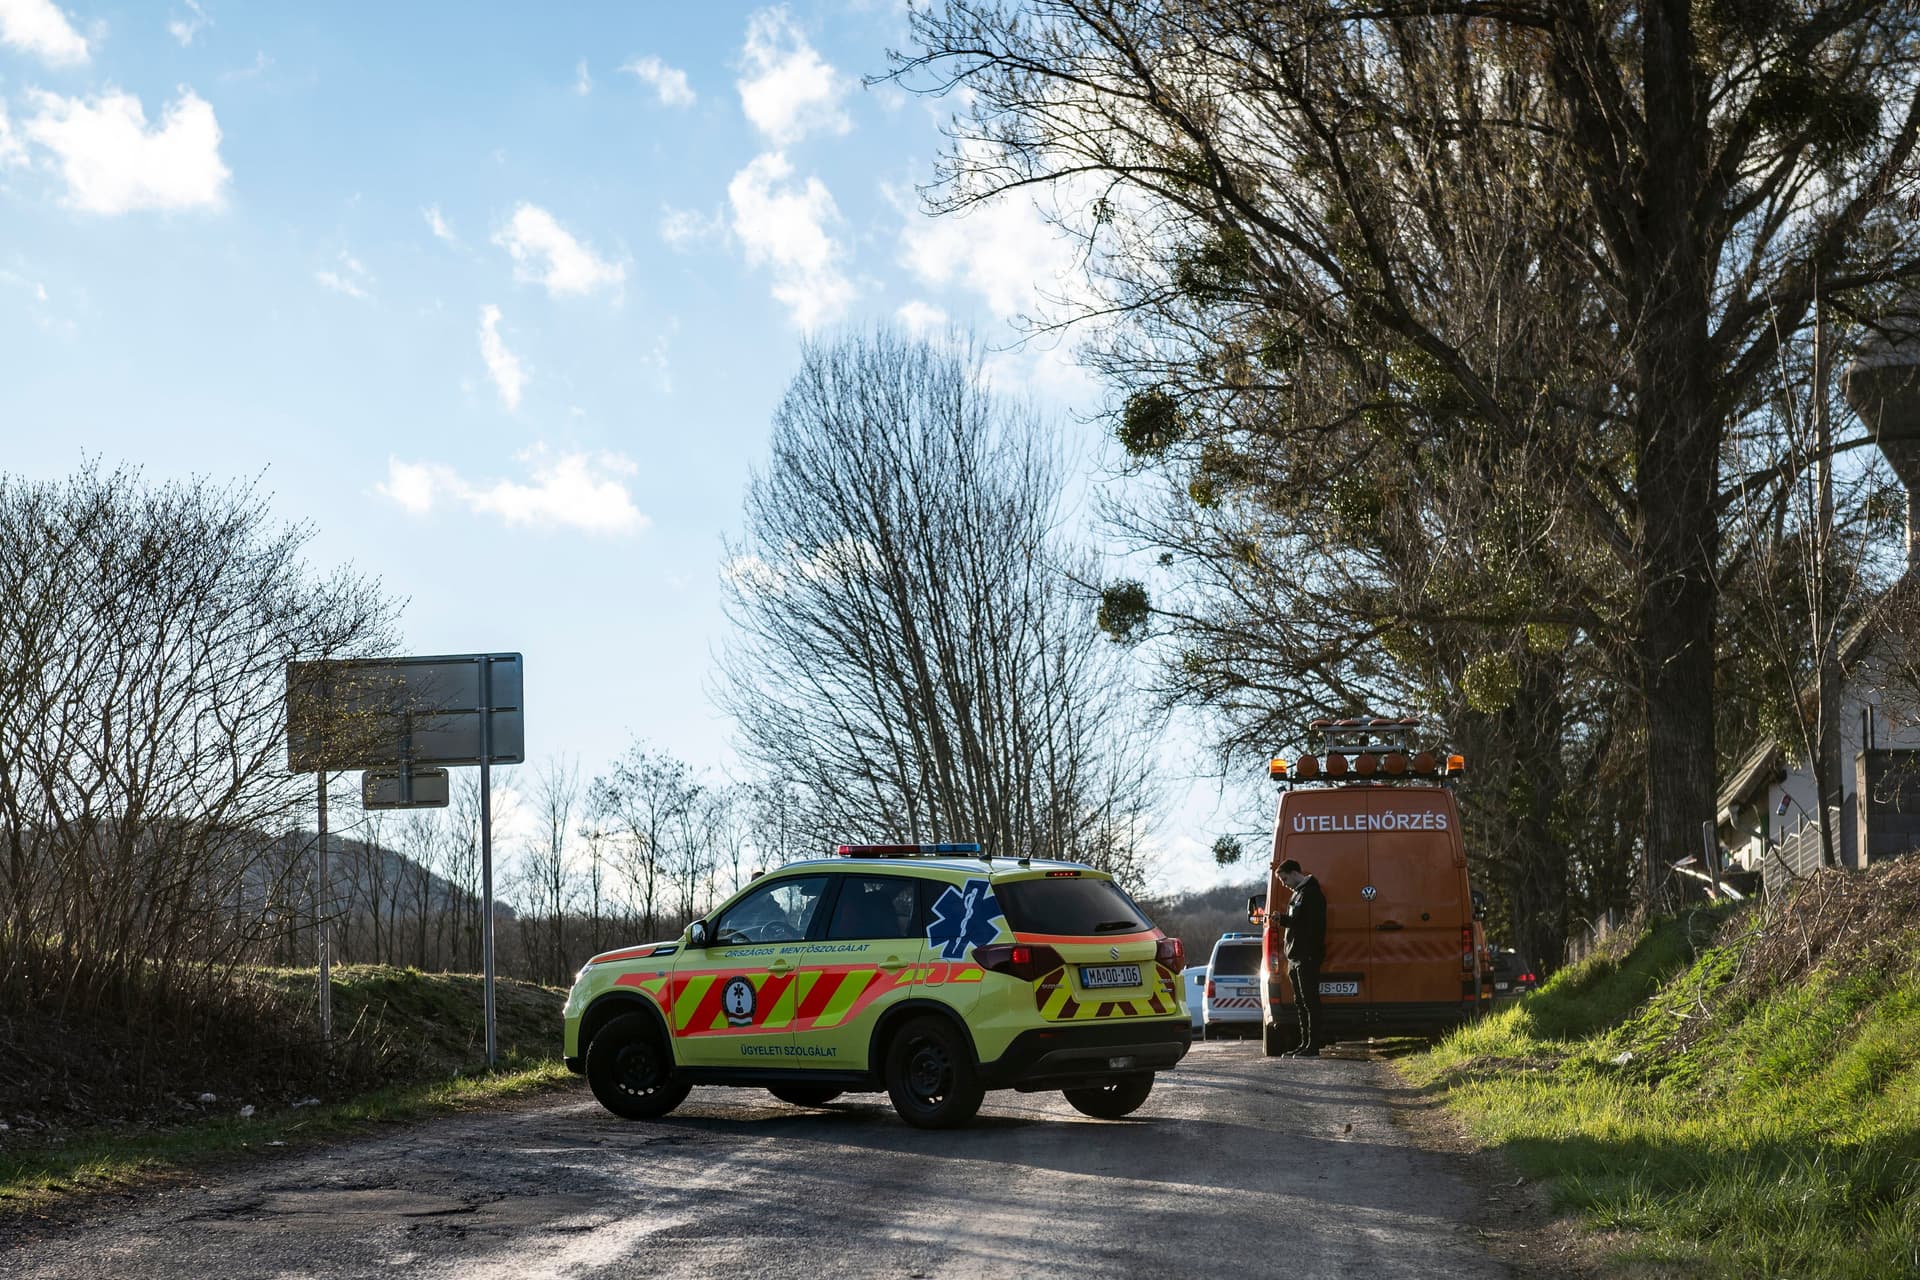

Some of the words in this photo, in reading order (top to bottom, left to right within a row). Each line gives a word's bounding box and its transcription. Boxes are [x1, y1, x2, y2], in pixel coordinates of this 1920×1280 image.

[1293, 810, 1448, 832] ÚTELLENŐRZÉS
[724, 947, 775, 958] ORSZÁGOS
[779, 943, 870, 955] MENTŐSZOLGÁLAT
[741, 1044, 782, 1055] ÜGYELETI
[784, 1044, 838, 1057] SZOLGÁLAT
